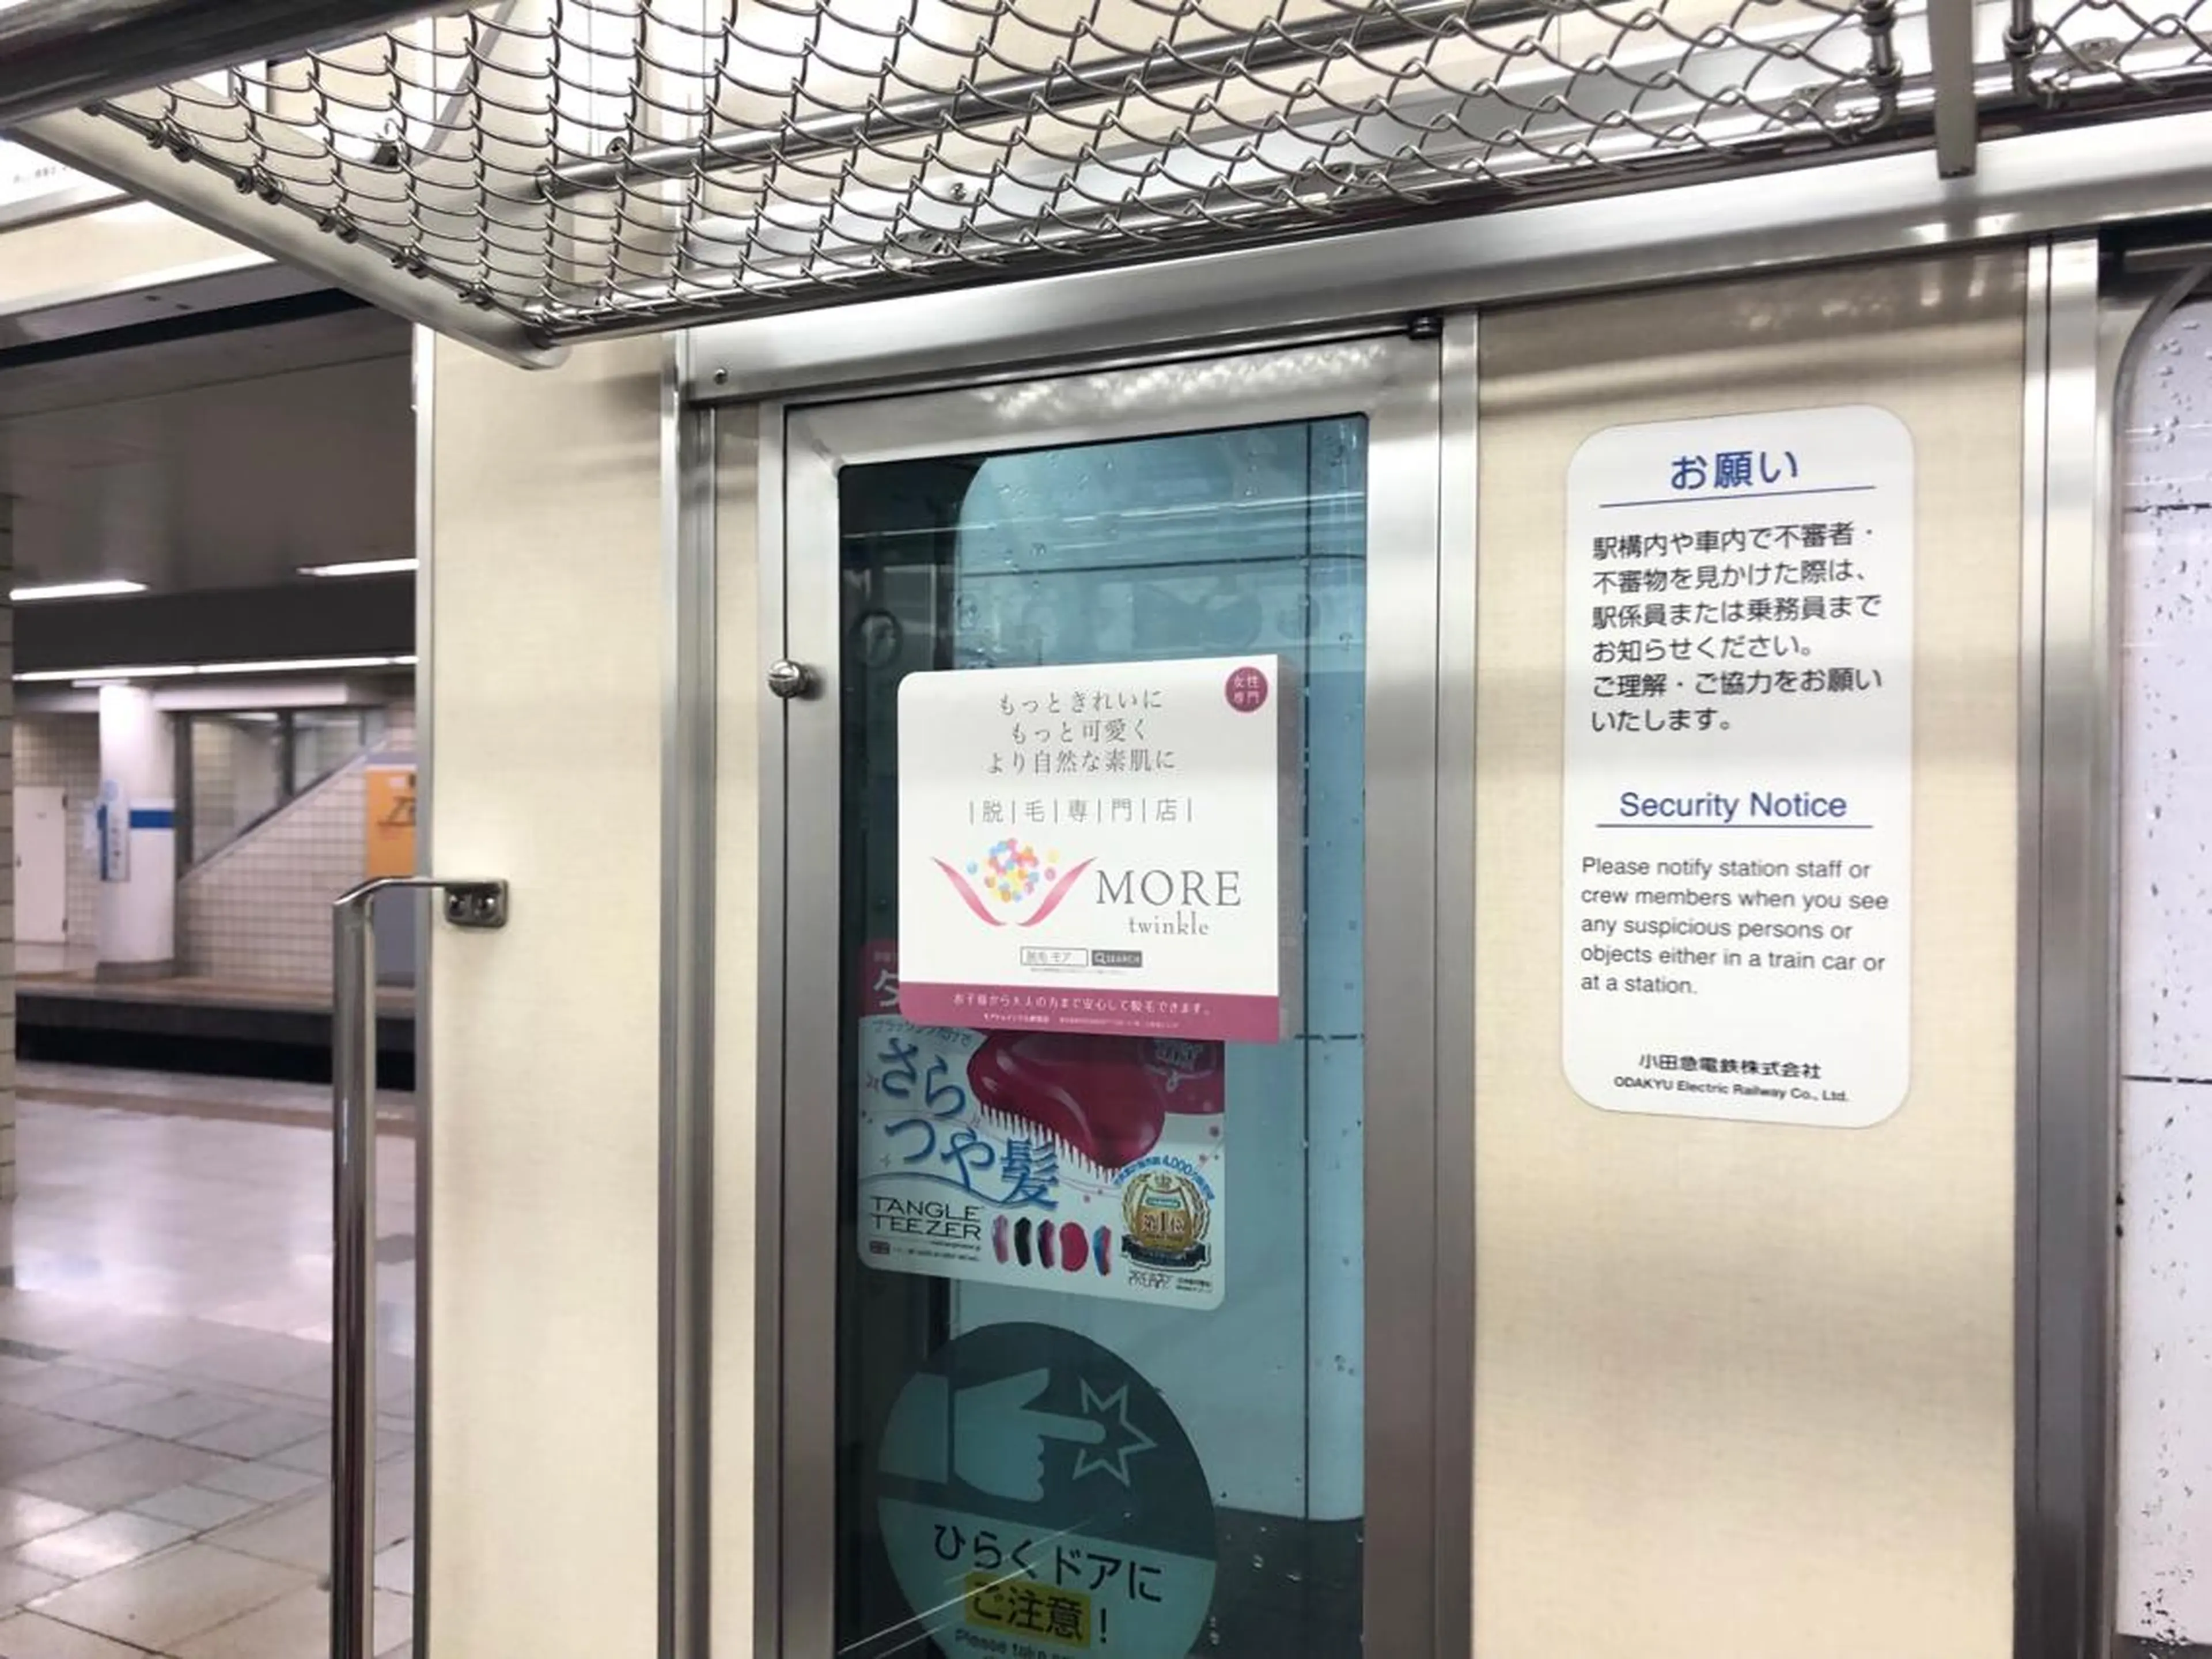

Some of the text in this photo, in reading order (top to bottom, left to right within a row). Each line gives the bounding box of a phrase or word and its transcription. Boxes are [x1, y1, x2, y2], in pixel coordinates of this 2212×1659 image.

[1670, 450, 1798, 490] お願い
[1592, 521, 1873, 560] 駅構内や車内で不審者・
[1592, 559, 1866, 594] 不審物を見かけた際は、
[1592, 594, 1882, 629] 駅係員または乗務員まで
[1592, 635, 1810, 664] お知らせください。
[1593, 667, 1882, 698] ご理解・ご協力をお願い
[999, 689, 1162, 717] もっときれいに
[1012, 717, 1144, 745] もっと可愛く
[1592, 707, 1729, 733] いたします。
[988, 746, 1176, 775] より自然な素肌に
[1619, 791, 1847, 824] Security Notice
[1582, 856, 1871, 881] Please notify station staff or
[1096, 869, 1241, 907] MORE
[1581, 888, 1889, 913] crew members when you see
[1128, 910, 1209, 935] twinkle
[1581, 918, 1853, 941] any suspicious persons or
[1580, 944, 1885, 972] objects either in a train car or
[1581, 975, 1698, 994] at a station.
[1639, 1054, 1821, 1080] 小田急電鉄株式会社
[1613, 1075, 1674, 1091] ODAKYU
[1676, 1080, 1729, 1094] Electric
[1732, 1084, 1787, 1100] Railway
[1821, 1089, 1849, 1102] Ltd.
[885, 1118, 1059, 1211] つや髪
[870, 1196, 980, 1222] TANGLE
[871, 1213, 982, 1240] TEEZER
[934, 1524, 1162, 1603] ひらくドアに
